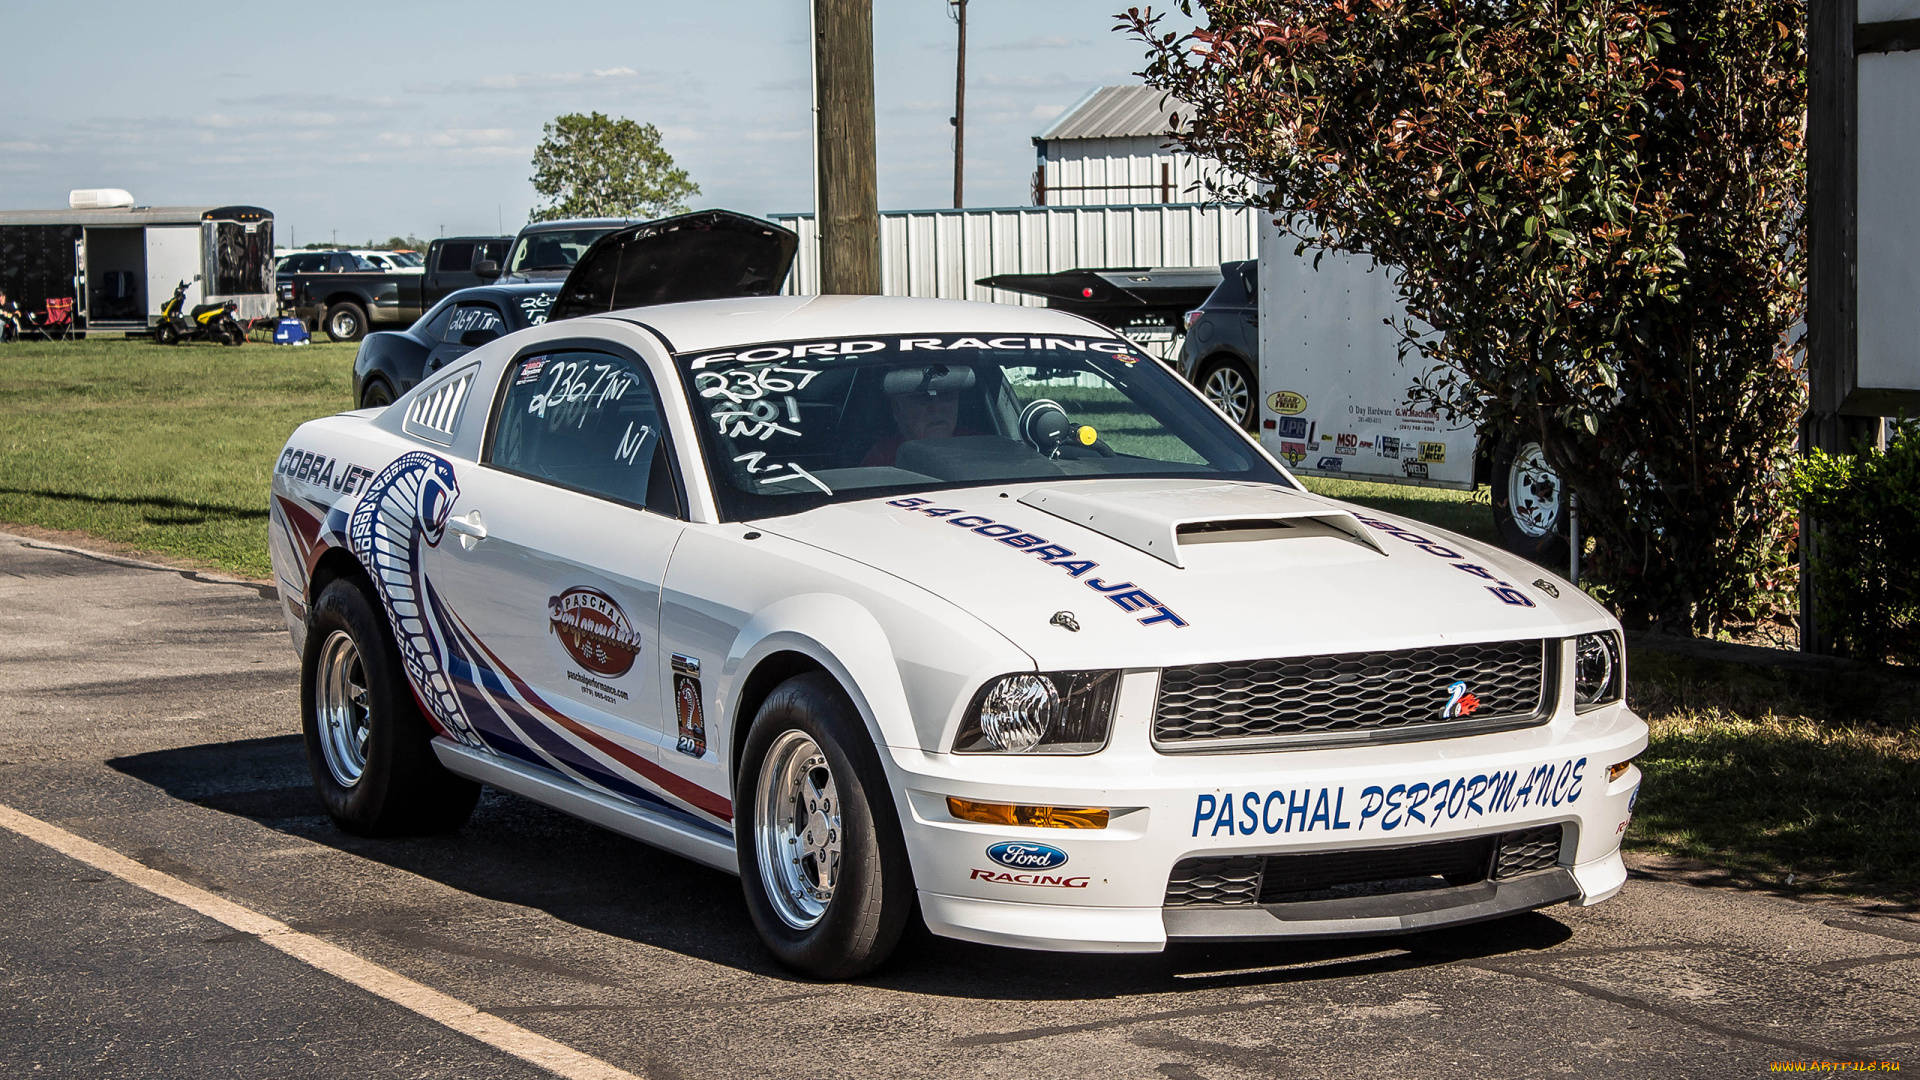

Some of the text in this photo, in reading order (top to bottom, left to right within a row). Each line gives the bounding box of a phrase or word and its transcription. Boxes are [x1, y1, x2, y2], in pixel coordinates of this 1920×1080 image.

[449, 310, 481, 330] 2647
[690, 337, 1129, 369] FORD RACING
[528, 360, 611, 419] 2367
[695, 367, 823, 403] 2367
[1355, 406, 1366, 416] Day
[1367, 407, 1392, 416] Hardware
[614, 421, 656, 465] NT
[1280, 420, 1304, 435] UPR
[1337, 433, 1358, 448] MSD
[1426, 444, 1442, 453] Auto
[278, 446, 376, 498] COBRA JET
[1407, 463, 1427, 474] WELD
[885, 497, 1190, 629] 5.4 COBRA JET
[565, 594, 622, 627] PASCHAL
[567, 670, 629, 701] paschalperformance.com
[1192, 756, 1588, 837] PASCHAL PERFORMANCE
[1002, 844, 1052, 867] Ford
[969, 868, 1090, 888] RACING
